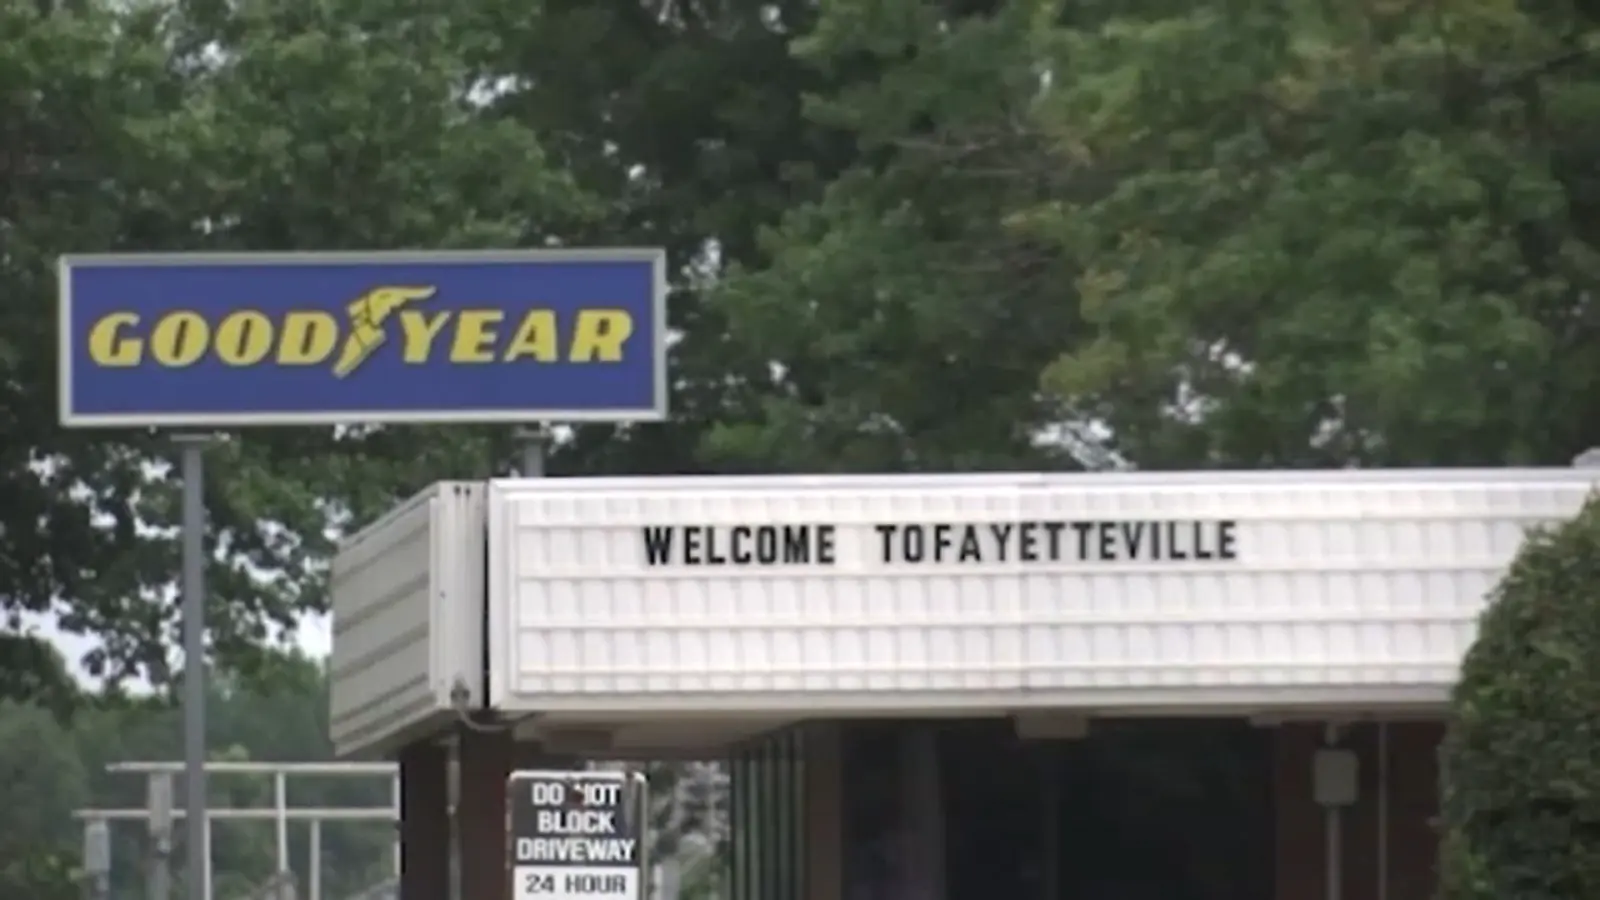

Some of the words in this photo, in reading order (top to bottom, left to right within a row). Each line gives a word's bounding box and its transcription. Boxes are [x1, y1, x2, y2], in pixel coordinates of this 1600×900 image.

[643, 525, 836, 565] WELCOME
[532, 783, 564, 806] DO
[537, 810, 615, 833] BLOCK
[517, 838, 635, 861] DRIVEWAY
[525, 874, 555, 894] 24
[565, 874, 627, 894] HOUR
